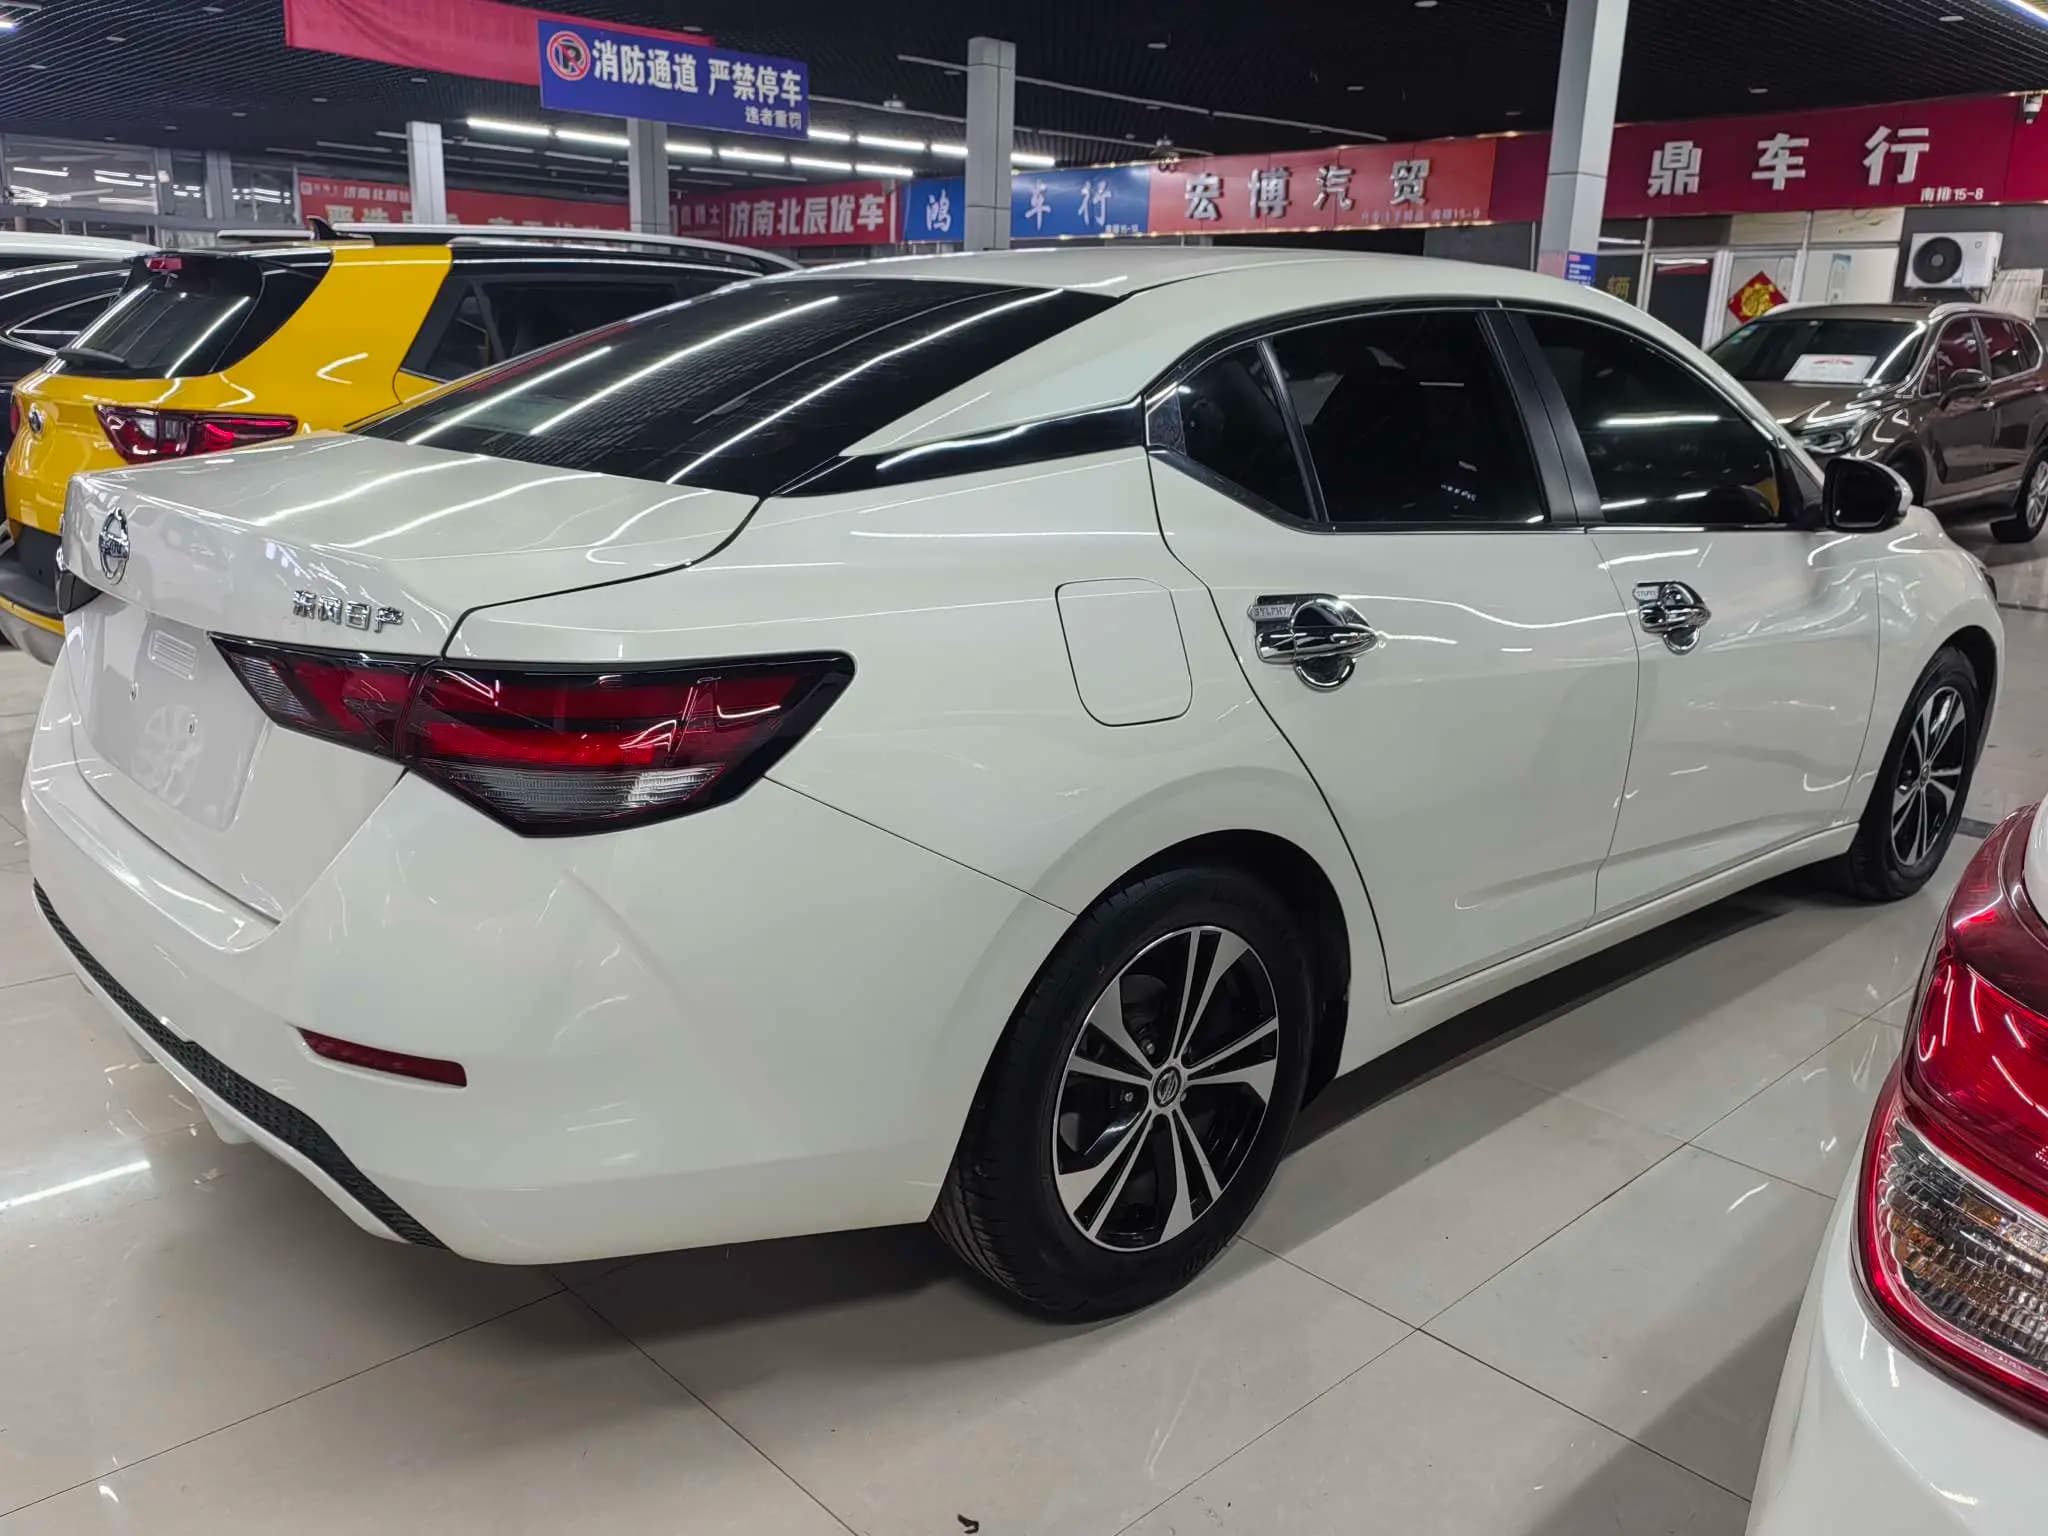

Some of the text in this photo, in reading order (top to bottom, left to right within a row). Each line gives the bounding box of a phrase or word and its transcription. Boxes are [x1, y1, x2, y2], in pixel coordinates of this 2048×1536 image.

[592, 39, 802, 107] 消防通道 严禁停车
[745, 106, 802, 130] 违者重罚
[1184, 159, 1430, 220] 宏博汽贸
[1920, 186, 1985, 203] 南排15-8
[728, 193, 885, 238] 济南北辰优车
[292, 590, 404, 633] 东风日产
